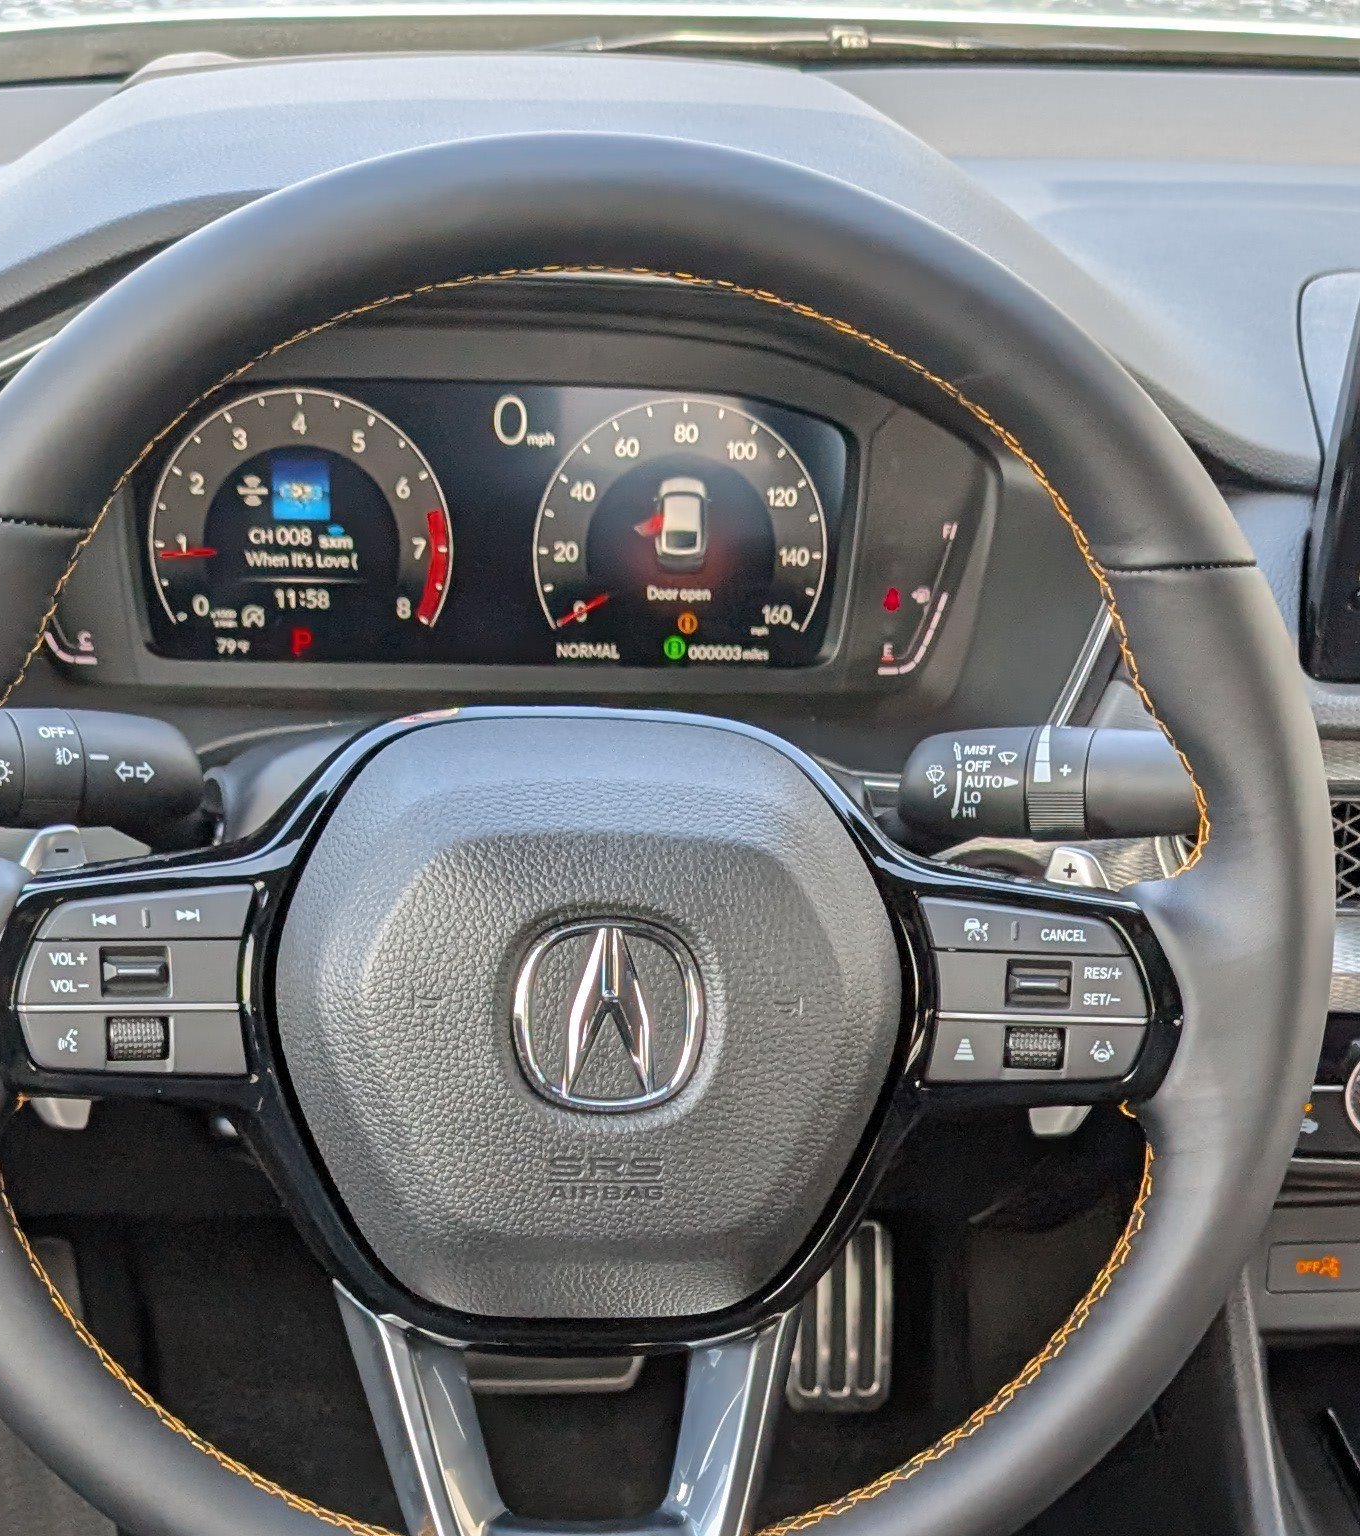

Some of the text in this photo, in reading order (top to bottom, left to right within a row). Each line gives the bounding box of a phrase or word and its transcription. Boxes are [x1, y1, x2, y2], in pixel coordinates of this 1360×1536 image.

[291, 411, 307, 435] 4
[493, 394, 556, 448] 0 mph
[232, 427, 248, 451] 3
[351, 429, 366, 453] 5
[673, 423, 699, 444] 80
[614, 438, 640, 458] 60
[727, 441, 758, 461] 100
[189, 471, 205, 495] 2
[395, 476, 411, 499] 6
[569, 481, 596, 502] 40
[767, 487, 798, 507] 120
[247, 527, 274, 545] CH
[275, 526, 313, 546] 008
[411, 537, 426, 560] 7
[552, 541, 579, 562] 20
[778, 547, 810, 567] 140
[244, 550, 289, 568] When
[315, 550, 350, 569] Love
[273, 588, 331, 610] 11:58
[646, 584, 712, 603] Door open
[192, 594, 210, 617] 0
[396, 597, 411, 619] 8
[761, 604, 793, 624] 160
[291, 627, 313, 656] P
[556, 644, 620, 661] NORMAL
[687, 644, 742, 661] 000003
[38, 726, 67, 739] OFF
[963, 744, 997, 756] MIST
[964, 760, 992, 772] OFF
[964, 775, 1003, 789] AUTO
[962, 791, 982, 804] LO
[961, 806, 977, 819] HI
[1040, 928, 1087, 942] CANCEL
[549, 1157, 661, 1181] SRS
[549, 1186, 663, 1200] AIRBAG
[1295, 1260, 1321, 1274] OFF
